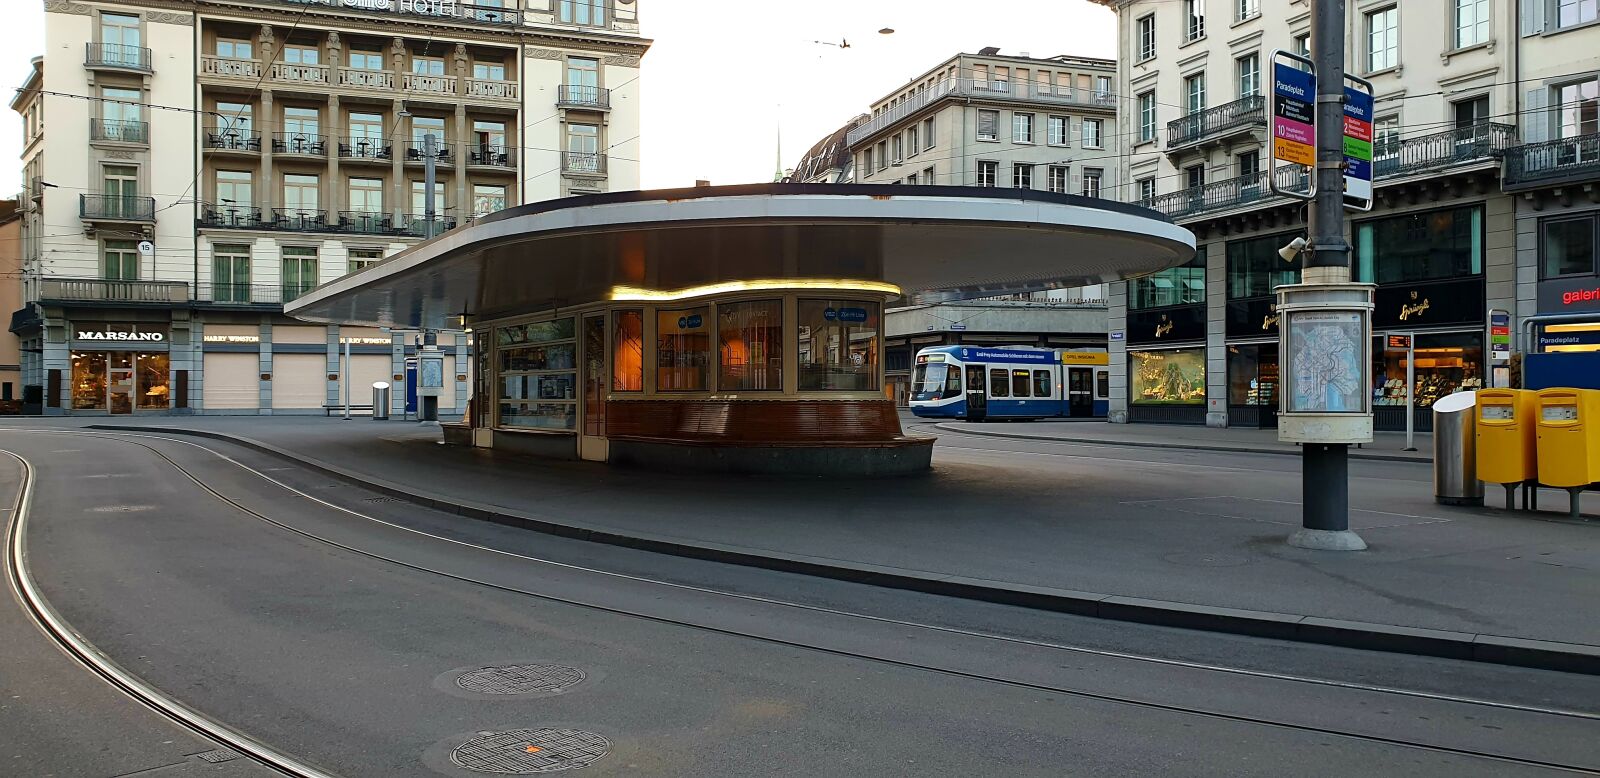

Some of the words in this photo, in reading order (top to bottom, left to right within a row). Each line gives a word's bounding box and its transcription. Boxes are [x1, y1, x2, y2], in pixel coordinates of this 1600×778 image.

[400, 0, 462, 17] HOTEL
[1276, 80, 1305, 96] Paradeplatz
[1280, 103, 1285, 114] 7
[1343, 103, 1364, 116] aradeplatz
[1277, 124, 1286, 136] 10
[1343, 122, 1348, 133] 2
[1277, 145, 1285, 157] 13
[1343, 142, 1348, 152] 8
[1399, 298, 1430, 321] Sprüngli
[78, 331, 163, 342] MARSANO
